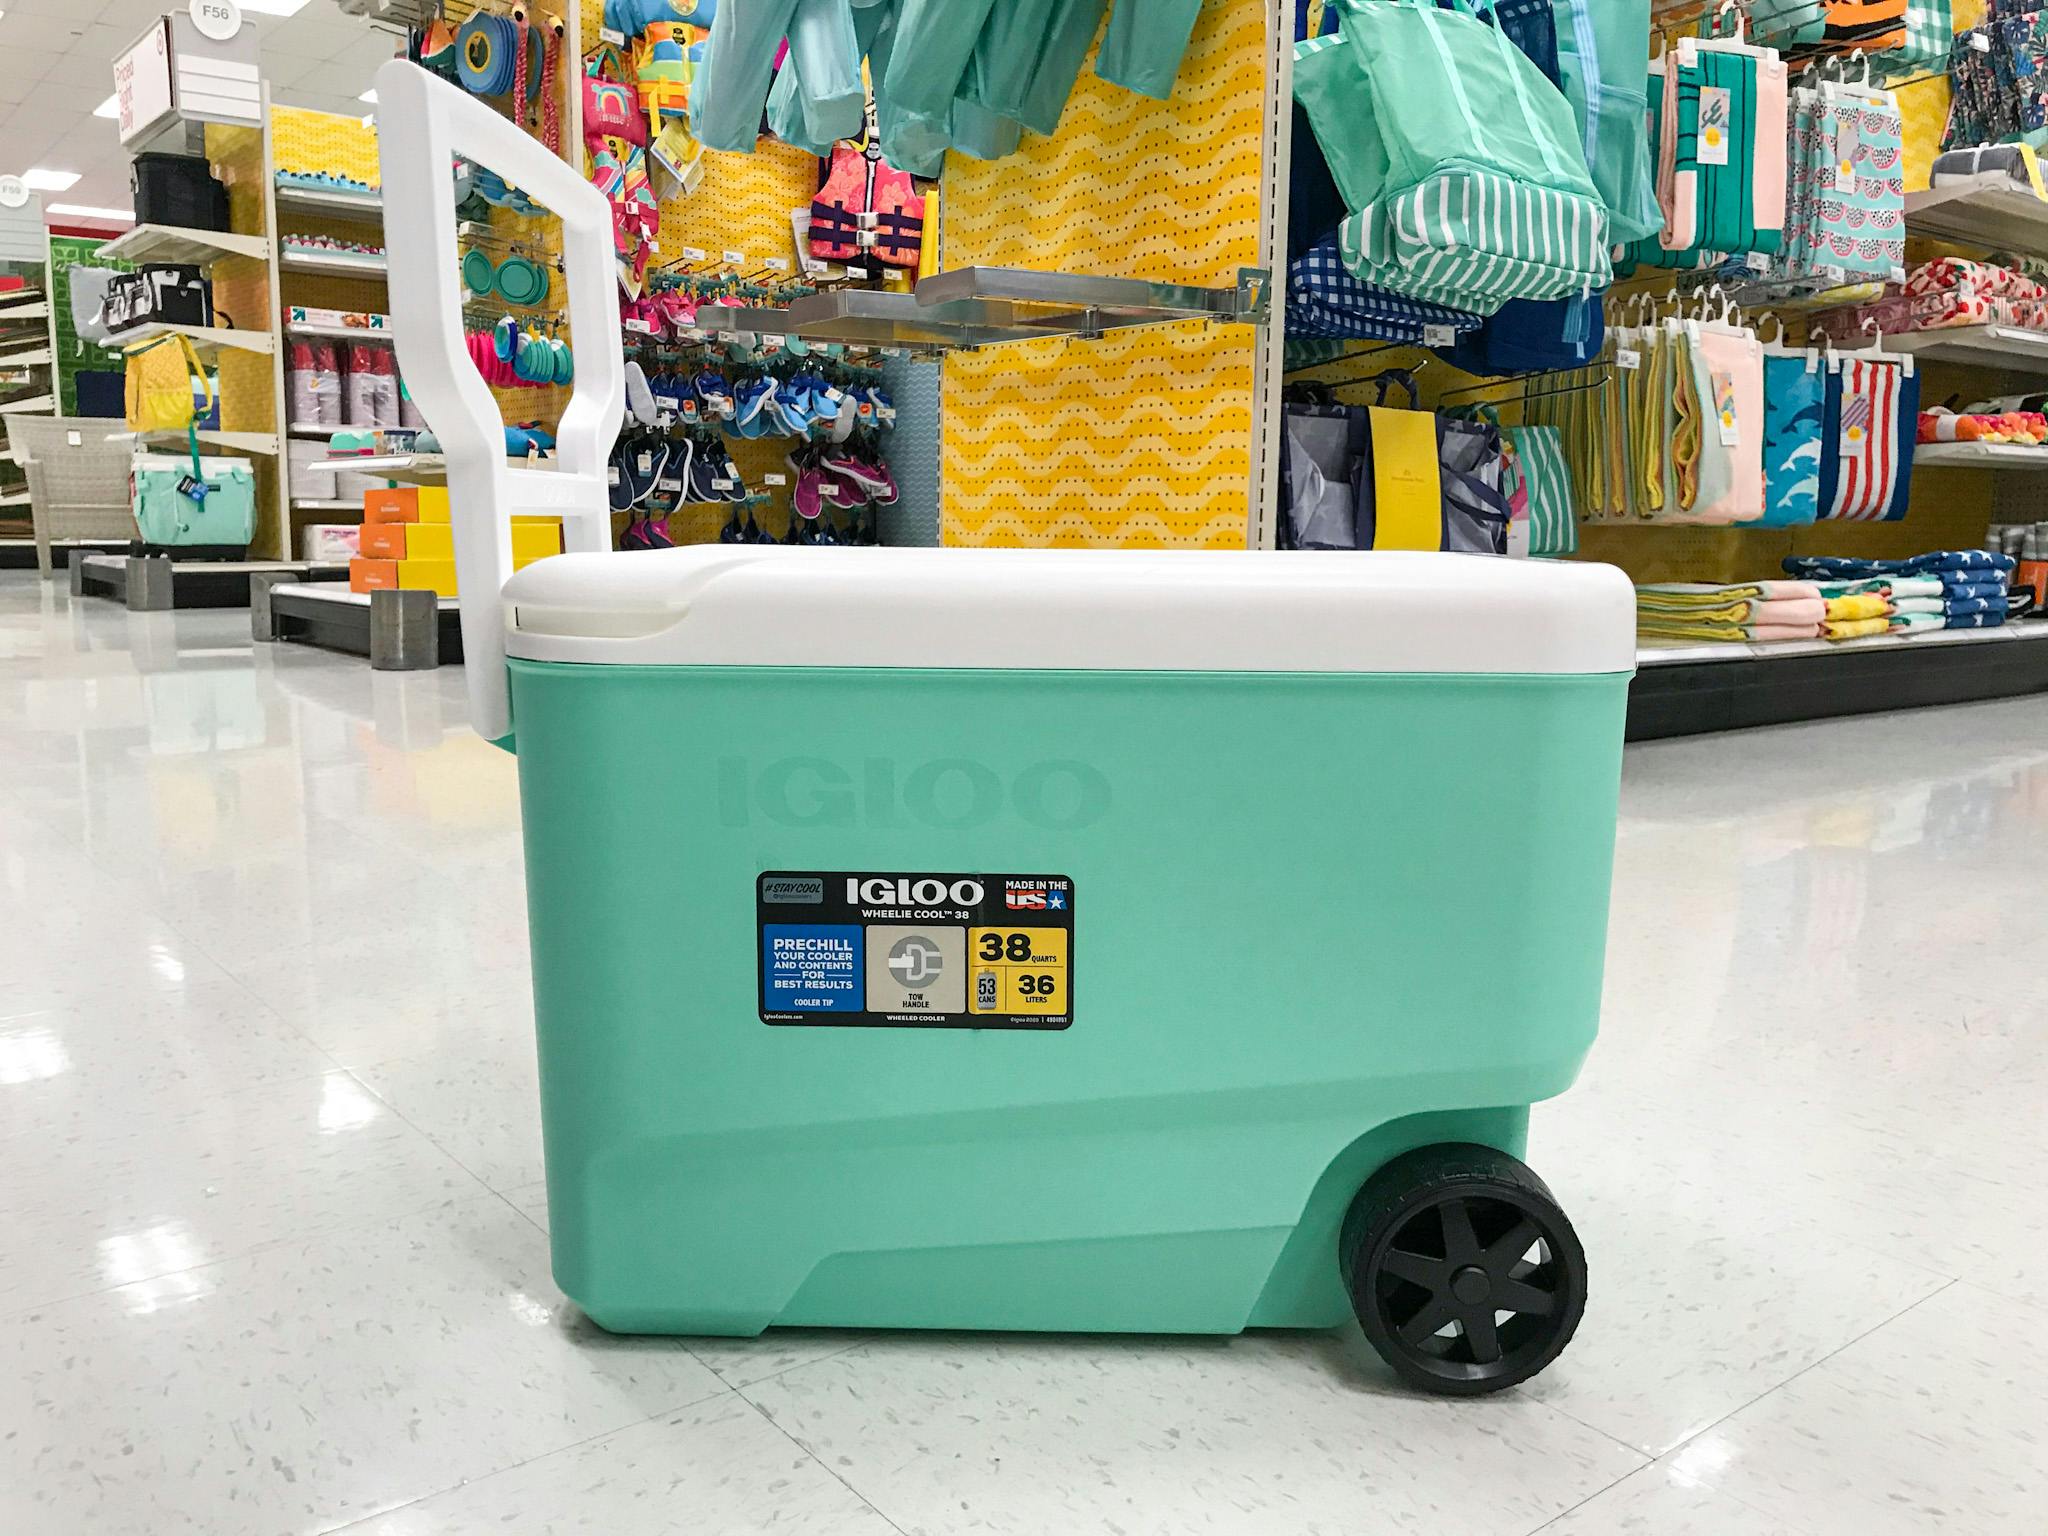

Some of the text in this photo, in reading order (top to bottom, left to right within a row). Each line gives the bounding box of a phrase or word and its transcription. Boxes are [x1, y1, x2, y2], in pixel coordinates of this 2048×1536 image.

[203, 5, 229, 20] F56
[718, 756, 1112, 831] IGLOO
[1005, 881, 1068, 890] MADE IN THE
[847, 878, 985, 906] IGLOO
[1005, 890, 1068, 910] USA
[861, 909, 912, 918] WHEELIE
[954, 911, 970, 919] 38
[774, 939, 853, 951] PRECHILL
[979, 933, 1032, 962] 38
[774, 952, 853, 961] YOUR COOLER
[1031, 955, 1057, 963] QUARTS
[774, 961, 853, 970] AND CONTENTS
[802, 971, 825, 979] FOR
[774, 980, 854, 990] BEST RESULTS
[978, 978, 996, 995] 53
[1018, 975, 1055, 995] 36
[794, 998, 820, 1006] COOLER
[908, 993, 924, 1001] TOW
